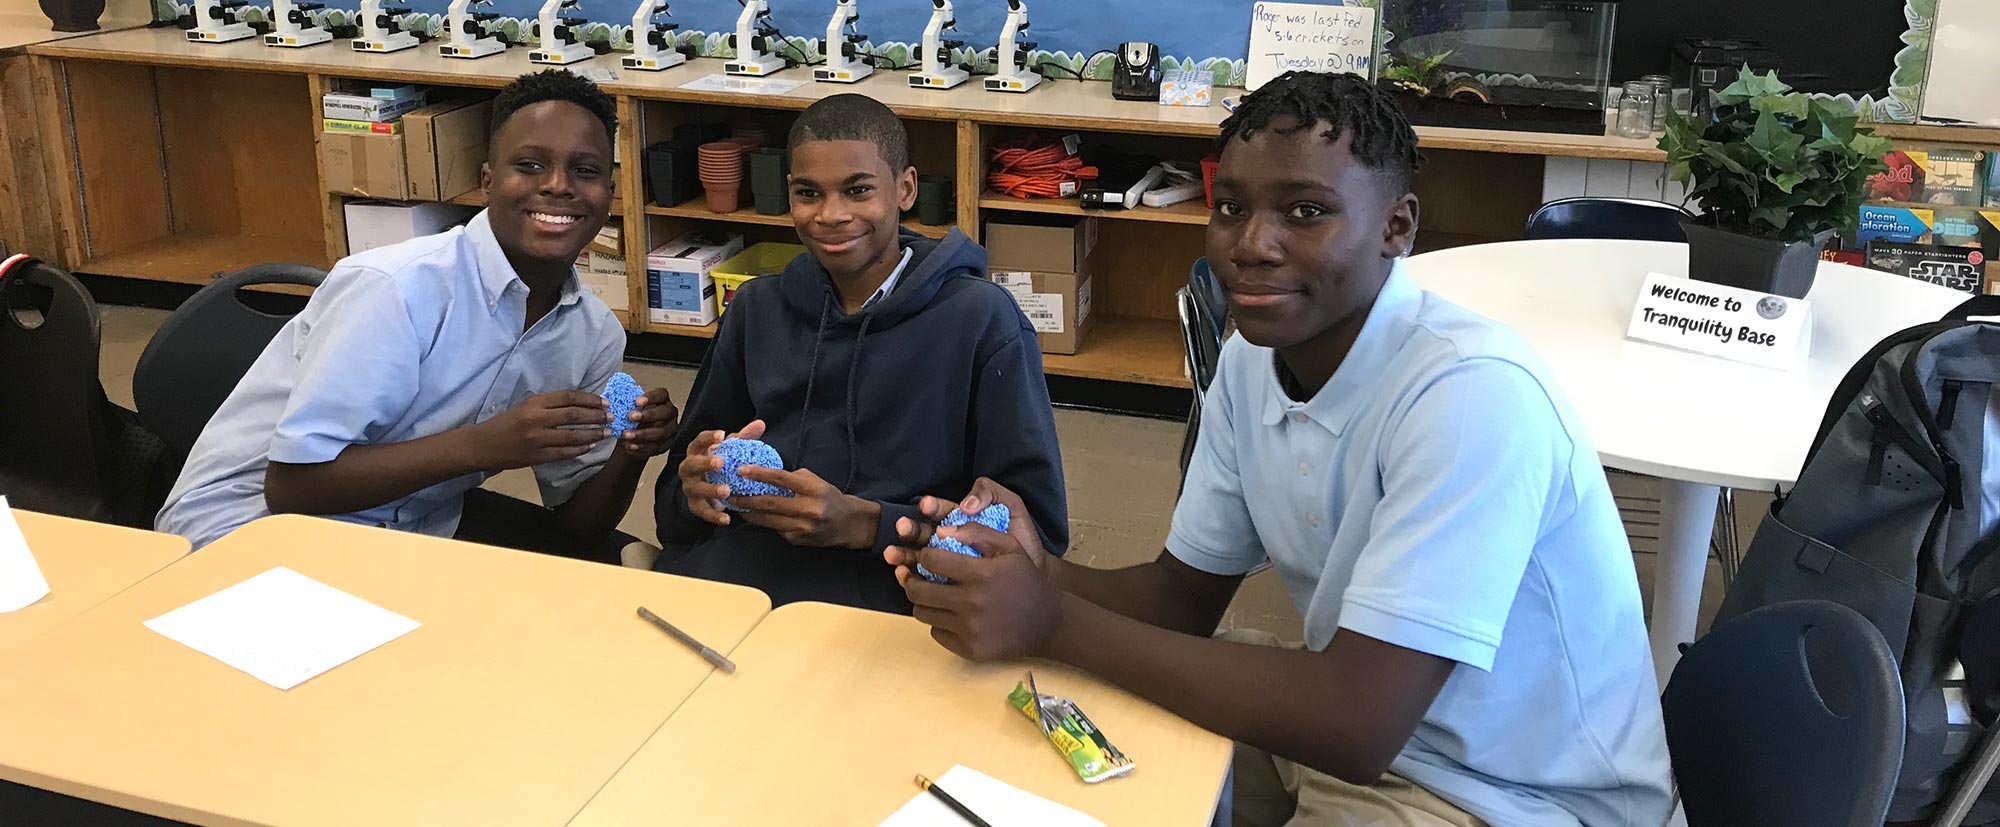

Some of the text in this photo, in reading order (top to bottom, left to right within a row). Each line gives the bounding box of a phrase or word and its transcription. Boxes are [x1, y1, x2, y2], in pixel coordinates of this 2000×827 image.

[1254, 4, 1362, 32] Roger was last fed
[1295, 31, 1348, 46] crickets
[1265, 53, 1324, 71] Tuesday
[1327, 53, 1343, 69] @
[1865, 211, 1896, 222] Ocean
[1860, 220, 1911, 233] ploration
[1932, 222, 1979, 236] DEEP
[703, 252, 722, 270] STAPLES
[1924, 251, 1967, 259] STARFIGHTERS
[1910, 261, 1979, 279] STAR
[1651, 284, 1742, 312] Welcome to
[1643, 307, 1776, 346] Tranquility Base
